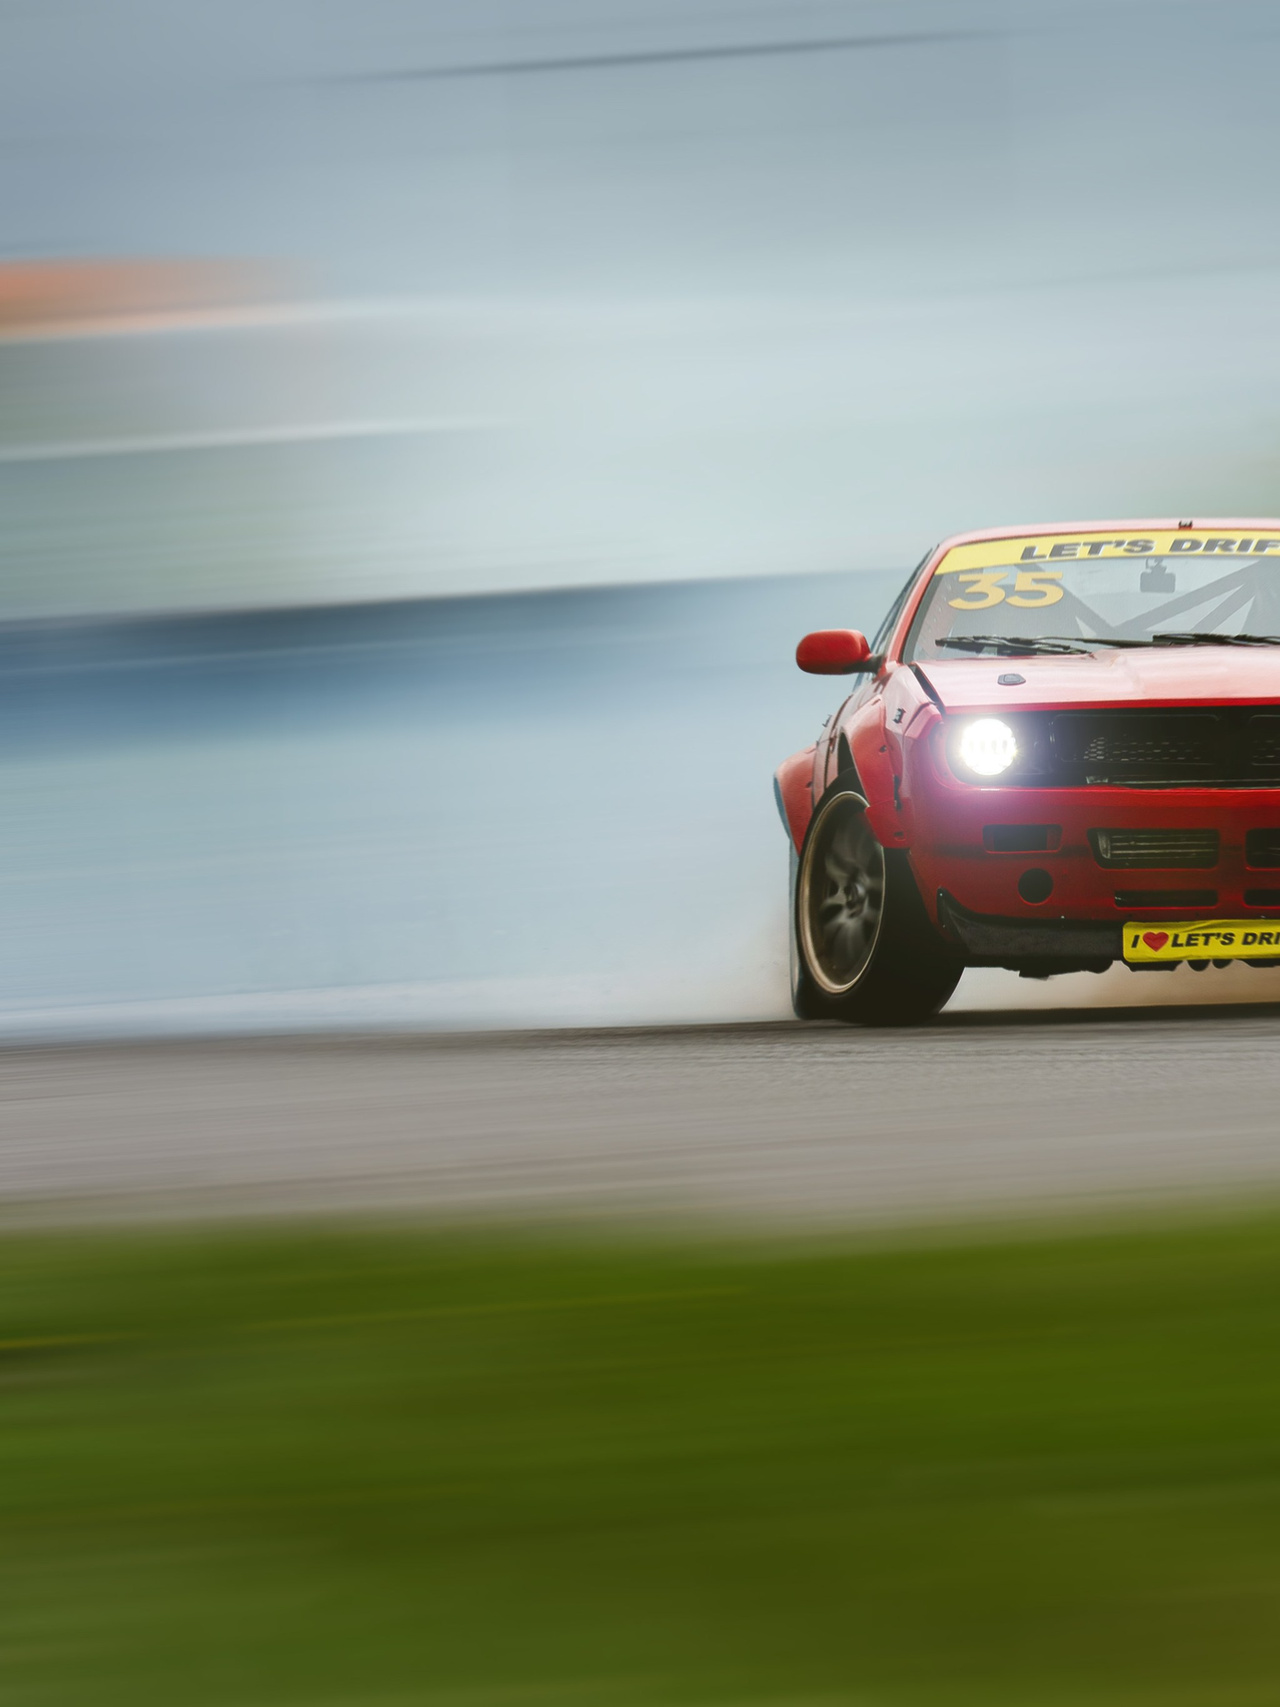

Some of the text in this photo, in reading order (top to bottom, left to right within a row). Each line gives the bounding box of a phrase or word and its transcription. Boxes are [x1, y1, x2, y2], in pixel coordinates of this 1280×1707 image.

[1020, 539, 1155, 561] LET'S
[948, 571, 1064, 611] 35
[1131, 935, 1140, 948] I
[1171, 932, 1235, 948] LET'S
